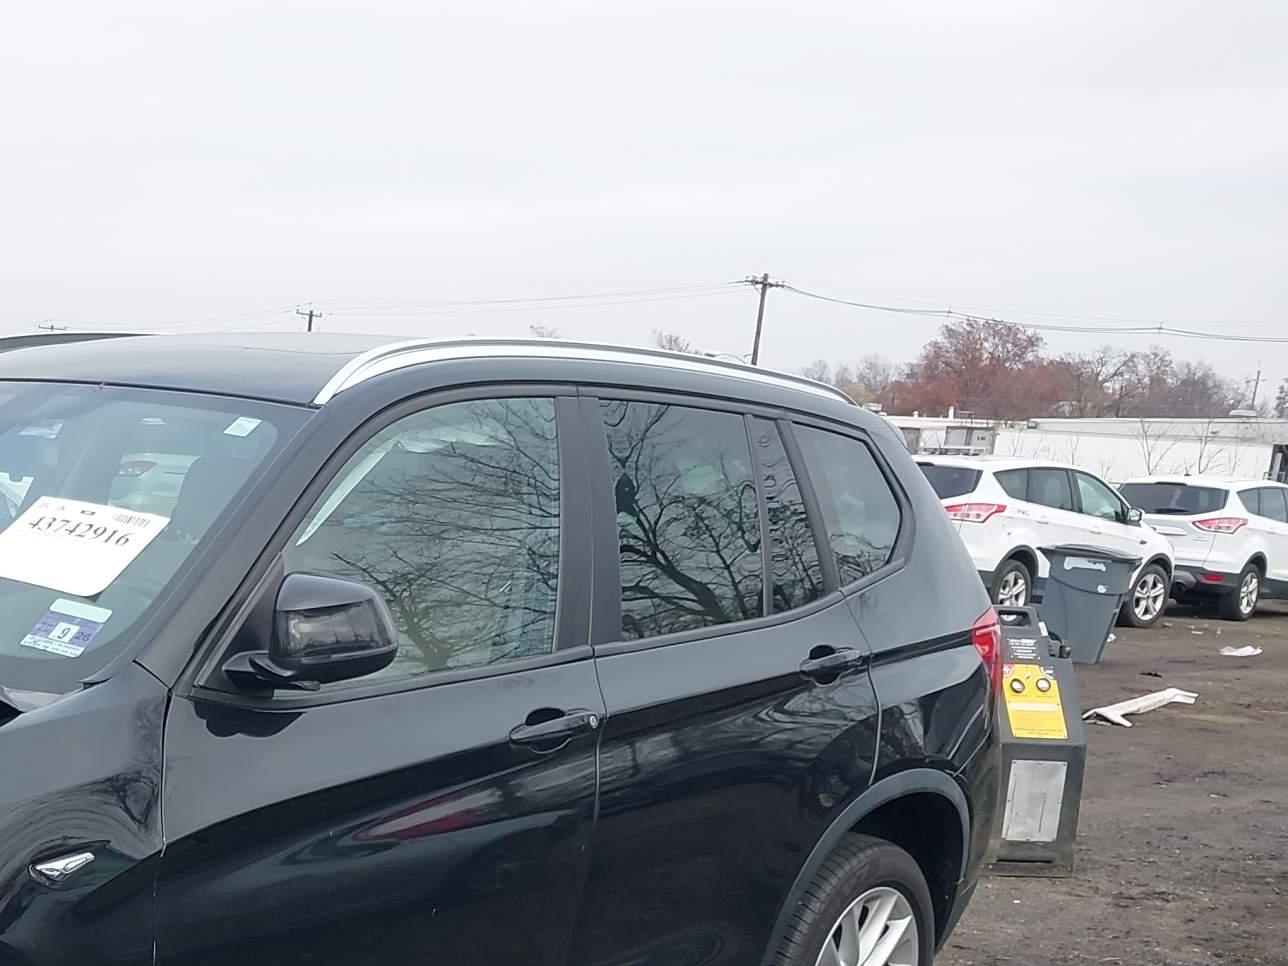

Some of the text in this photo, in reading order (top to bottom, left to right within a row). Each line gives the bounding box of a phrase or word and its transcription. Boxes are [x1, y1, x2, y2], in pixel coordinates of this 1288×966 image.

[28, 515, 134, 547] 43742916
[57, 627, 71, 641] 9
[75, 631, 92, 643] 26
